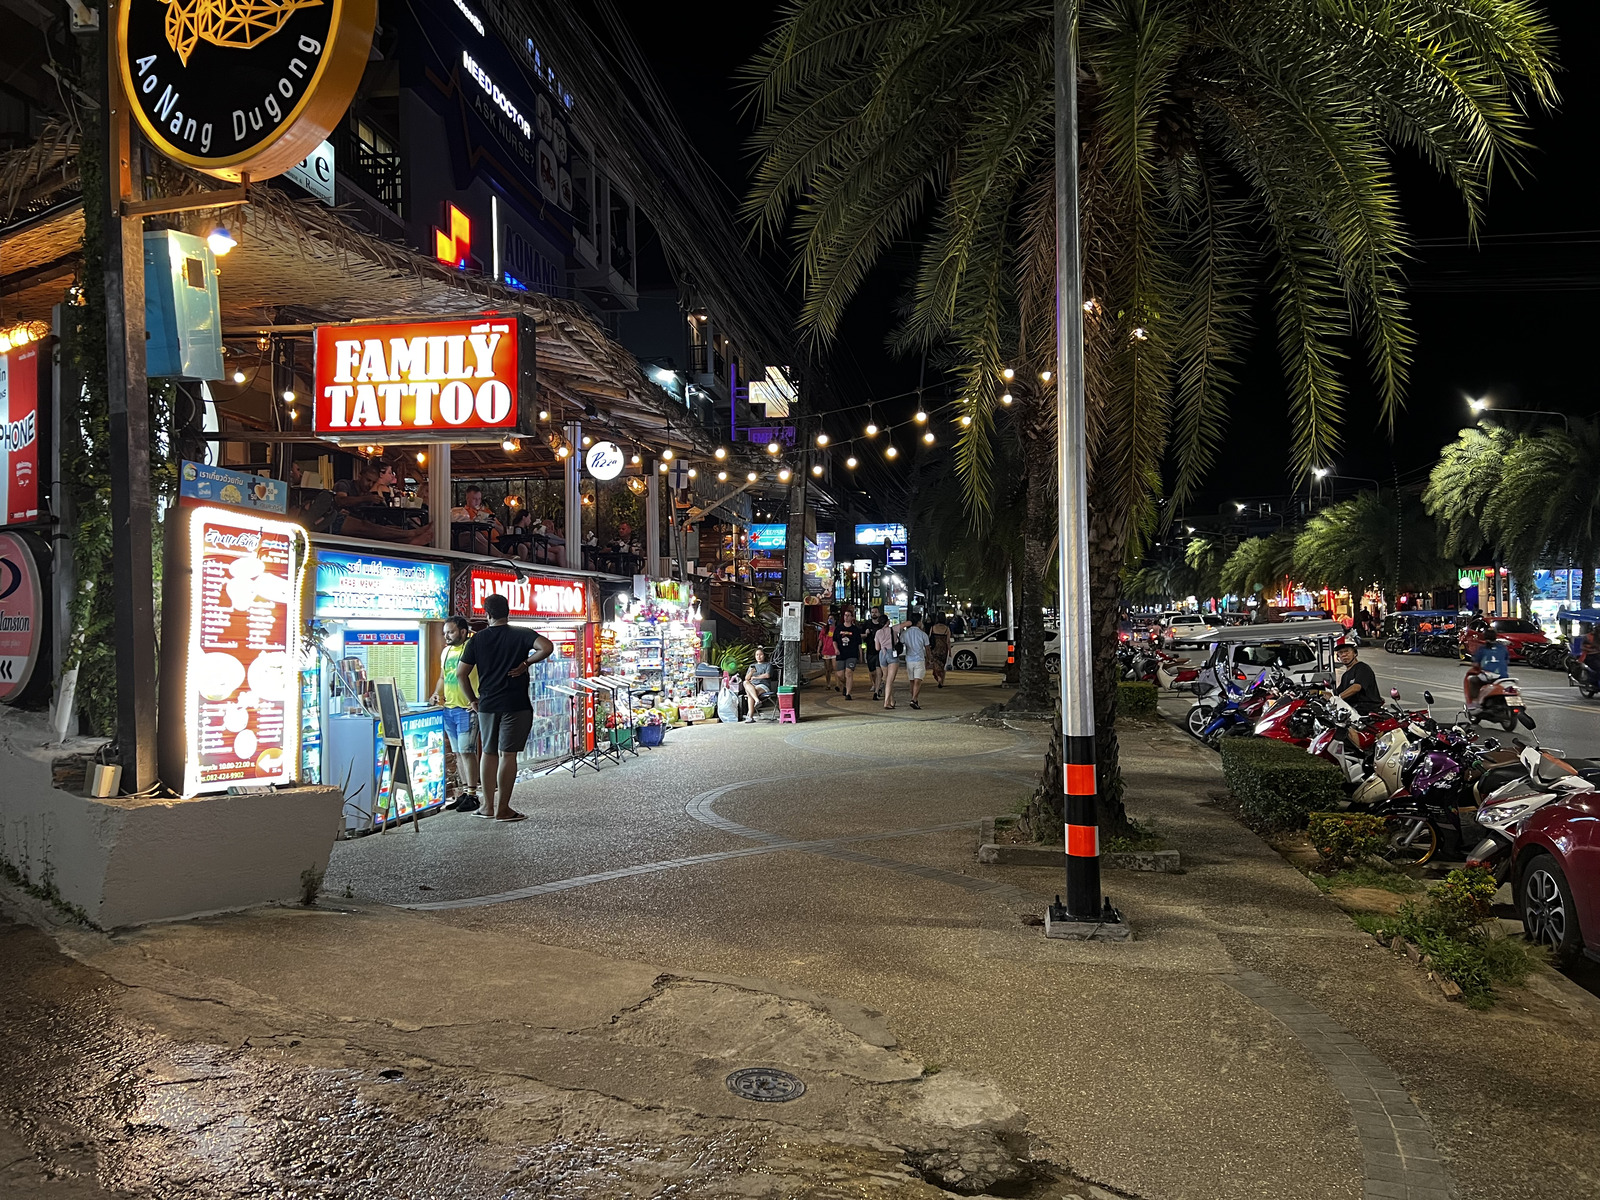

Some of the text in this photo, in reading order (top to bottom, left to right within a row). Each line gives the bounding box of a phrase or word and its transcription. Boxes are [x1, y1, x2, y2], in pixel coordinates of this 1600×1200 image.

[232, 34, 322, 142] Dugong
[463, 50, 492, 95] NEED
[475, 95, 535, 168] ASK NURSE?
[504, 224, 558, 297] AONANG
[334, 333, 501, 383] FAMILY
[324, 379, 512, 427] TATTOO
[473, 577, 582, 613] FAMILY TATTOO
[0, 610, 30, 632] ansion
[357, 633, 405, 641] TIME TABLE
[586, 647, 594, 733] TATOO
[409, 715, 443, 730] INFORMATION
